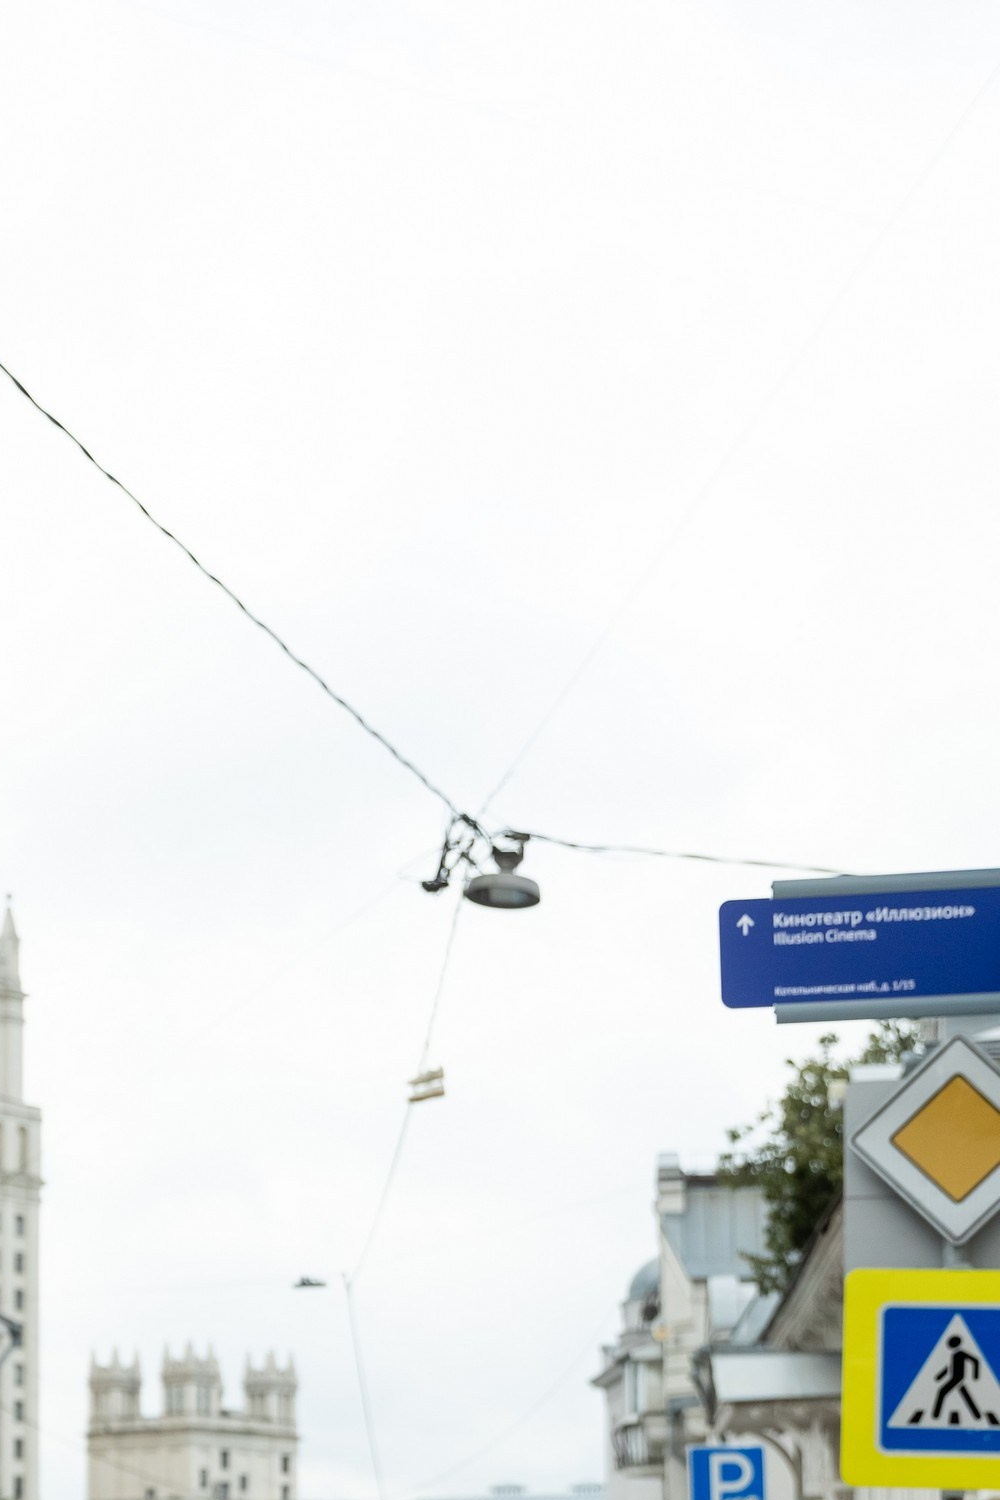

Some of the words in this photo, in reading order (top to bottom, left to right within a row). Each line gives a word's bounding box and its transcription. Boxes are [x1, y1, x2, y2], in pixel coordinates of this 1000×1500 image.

[773, 911, 863, 928] Кинотеатр
[865, 906, 976, 923] «Иллюзион»
[773, 930, 824, 945] Illusion
[825, 928, 877, 943] Cinema
